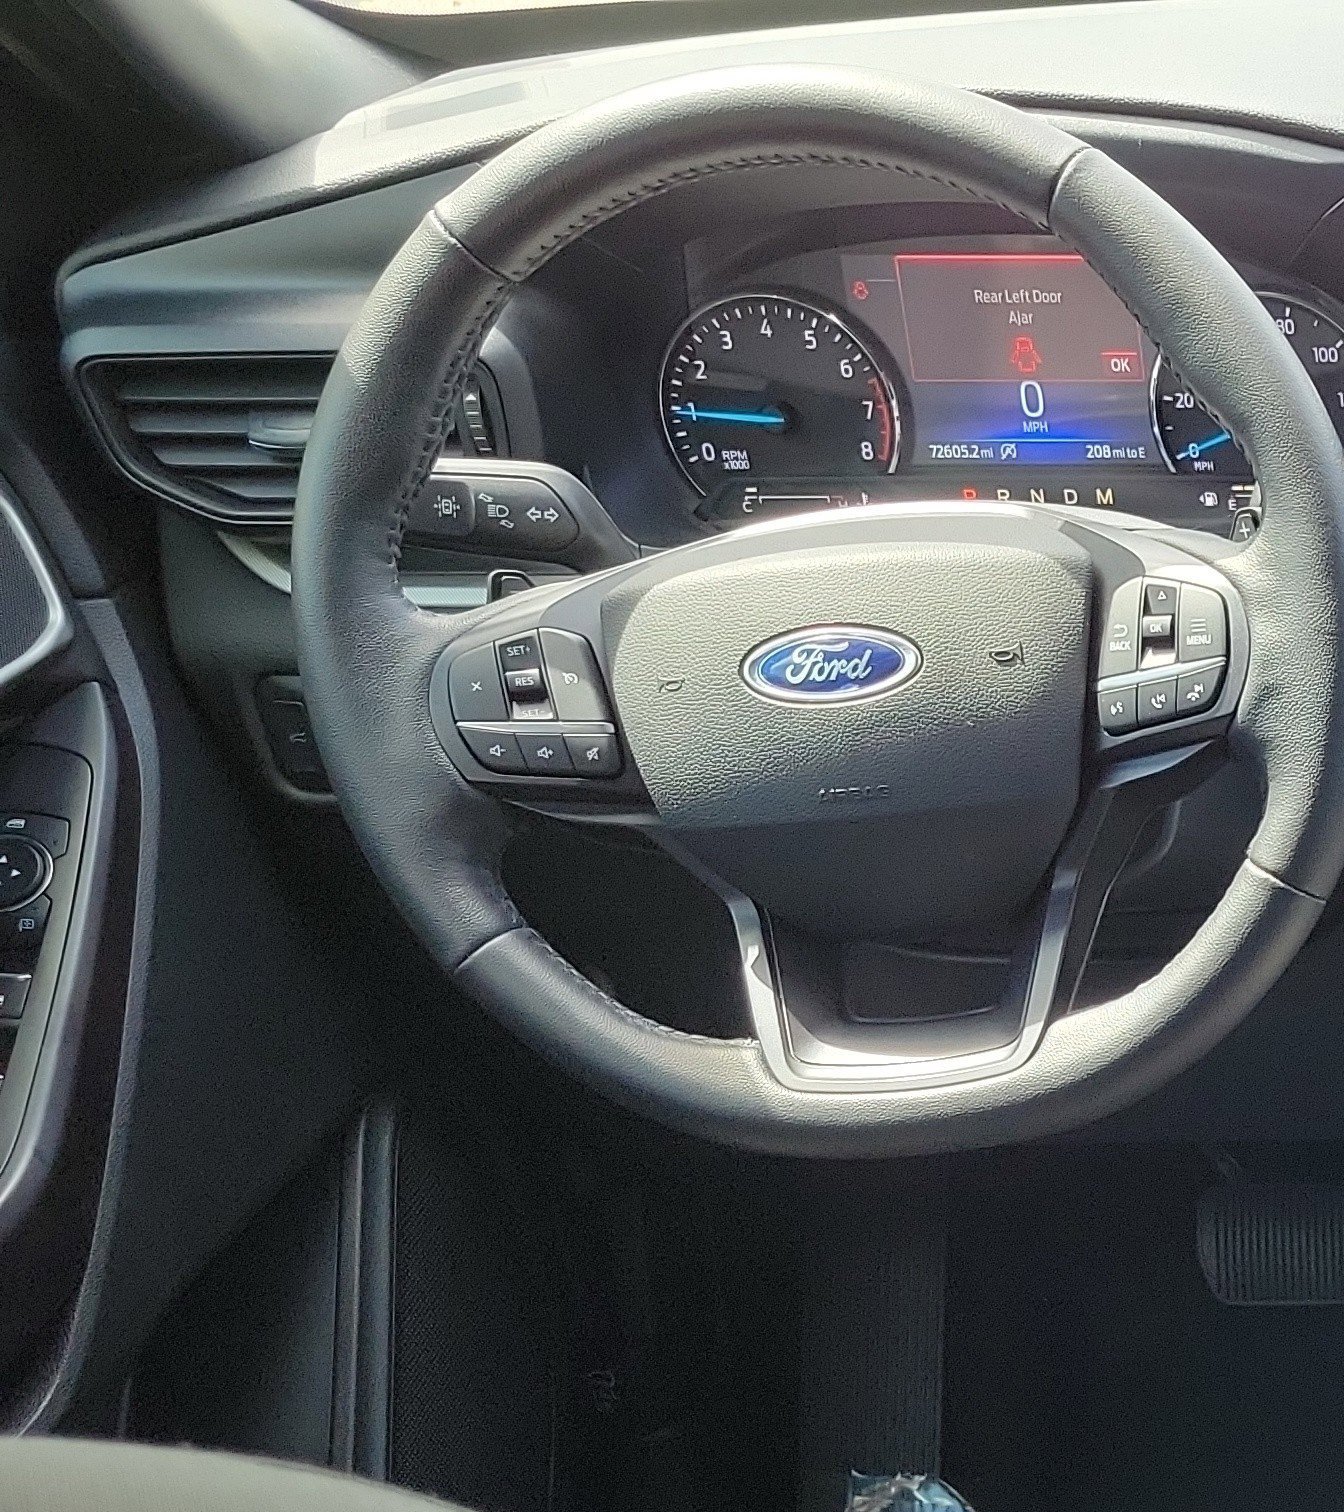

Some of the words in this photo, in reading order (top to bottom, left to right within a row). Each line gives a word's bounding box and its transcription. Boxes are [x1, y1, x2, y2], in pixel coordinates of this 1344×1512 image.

[974, 289, 1003, 304] Rear
[1005, 288, 1031, 304] Left
[1033, 289, 1062, 304] Door
[1008, 311, 1033, 326] Ajar
[760, 318, 772, 338] 4
[719, 330, 733, 350] 3
[804, 330, 817, 350] 5
[1312, 347, 1338, 363] 100
[693, 360, 707, 380] 2
[840, 359, 853, 378] 6
[1110, 358, 1131, 373] OK
[1019, 380, 1045, 418] 0
[1174, 393, 1194, 409] 20
[861, 401, 874, 420] 7
[1023, 421, 1049, 433] MPH
[701, 442, 715, 461] 0
[721, 450, 748, 461] RPM
[860, 442, 874, 461] 8
[928, 445, 981, 459] 72605.2
[1085, 445, 1112, 459] 208
[723, 460, 750, 470] x1000
[1194, 461, 1214, 472] MPH
[997, 488, 1010, 502] R
[1030, 488, 1044, 504] N
[1063, 489, 1078, 505] D
[1095, 488, 1114, 505] M
[1149, 623, 1163, 633] OK
[1109, 641, 1131, 652] BACK
[1186, 634, 1212, 646] MENU
[785, 641, 873, 685] Ford
[515, 676, 535, 687] RES
